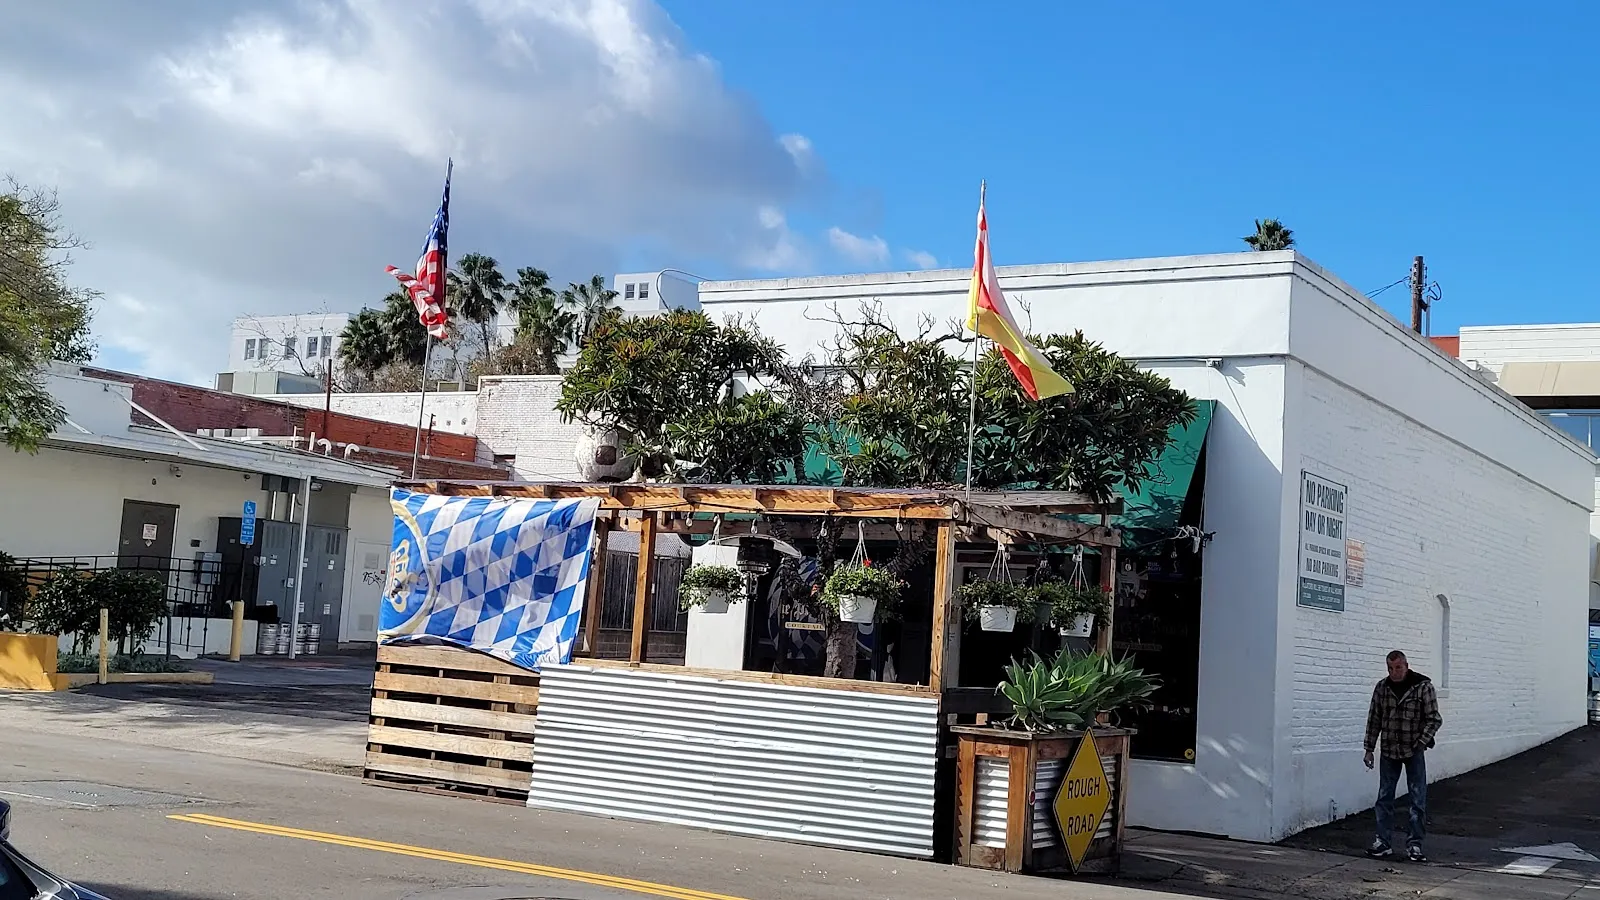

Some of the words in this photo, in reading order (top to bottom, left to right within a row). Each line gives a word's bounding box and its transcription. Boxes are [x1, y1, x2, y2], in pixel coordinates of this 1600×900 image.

[1305, 480, 1315, 505] NO
[1317, 483, 1344, 514] PARKING
[1305, 510, 1316, 532] DAY
[1317, 513, 1326, 535] OR
[1326, 516, 1343, 540] NIGHT
[1306, 558, 1312, 572] NO
[1312, 559, 1321, 574] BAR
[1321, 561, 1339, 578] PARKING
[1067, 777, 1101, 800] ROUGH
[1067, 813, 1095, 836] ROAD
